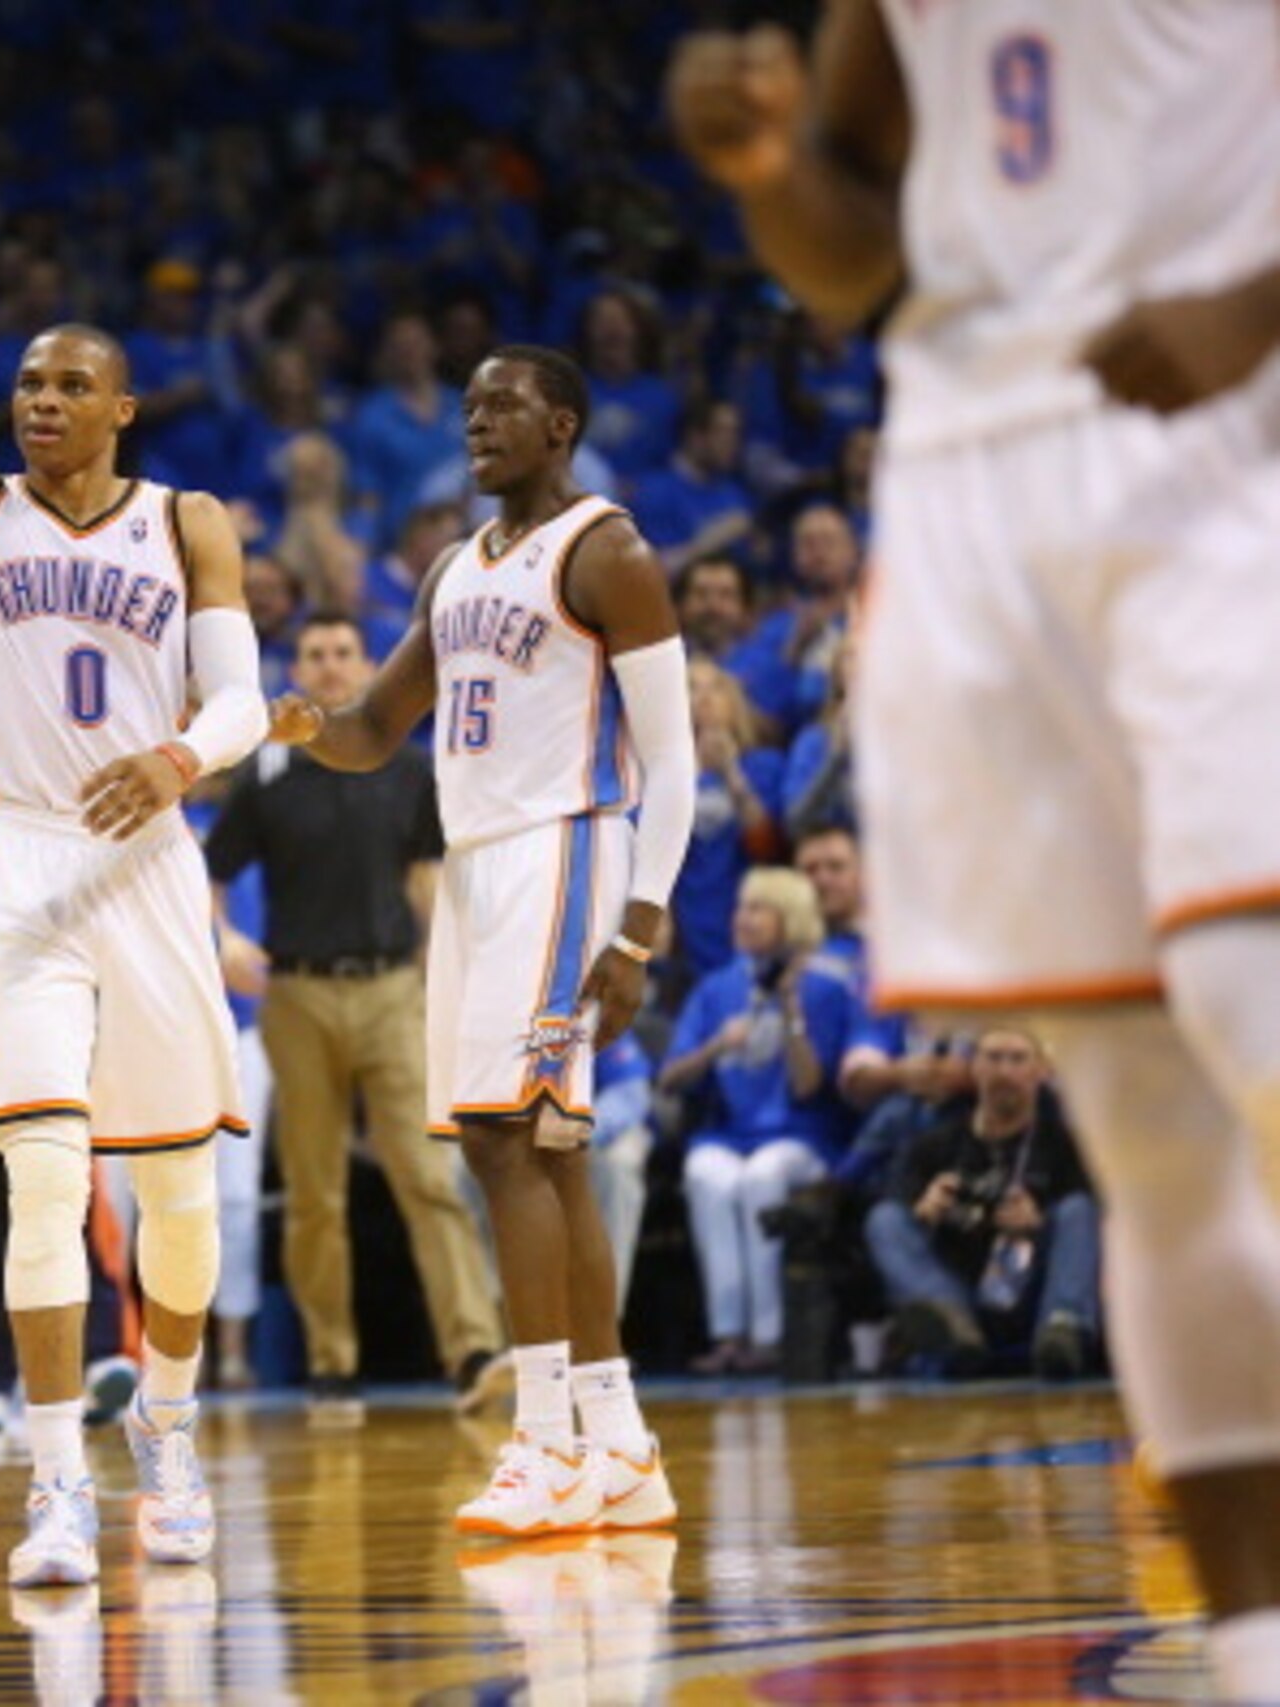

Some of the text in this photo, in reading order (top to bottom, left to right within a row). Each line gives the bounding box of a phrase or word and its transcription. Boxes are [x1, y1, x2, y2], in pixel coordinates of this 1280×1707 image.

[988, 30, 1058, 188] 9
[66, 644, 108, 730] 0
[447, 674, 496, 755] 15
